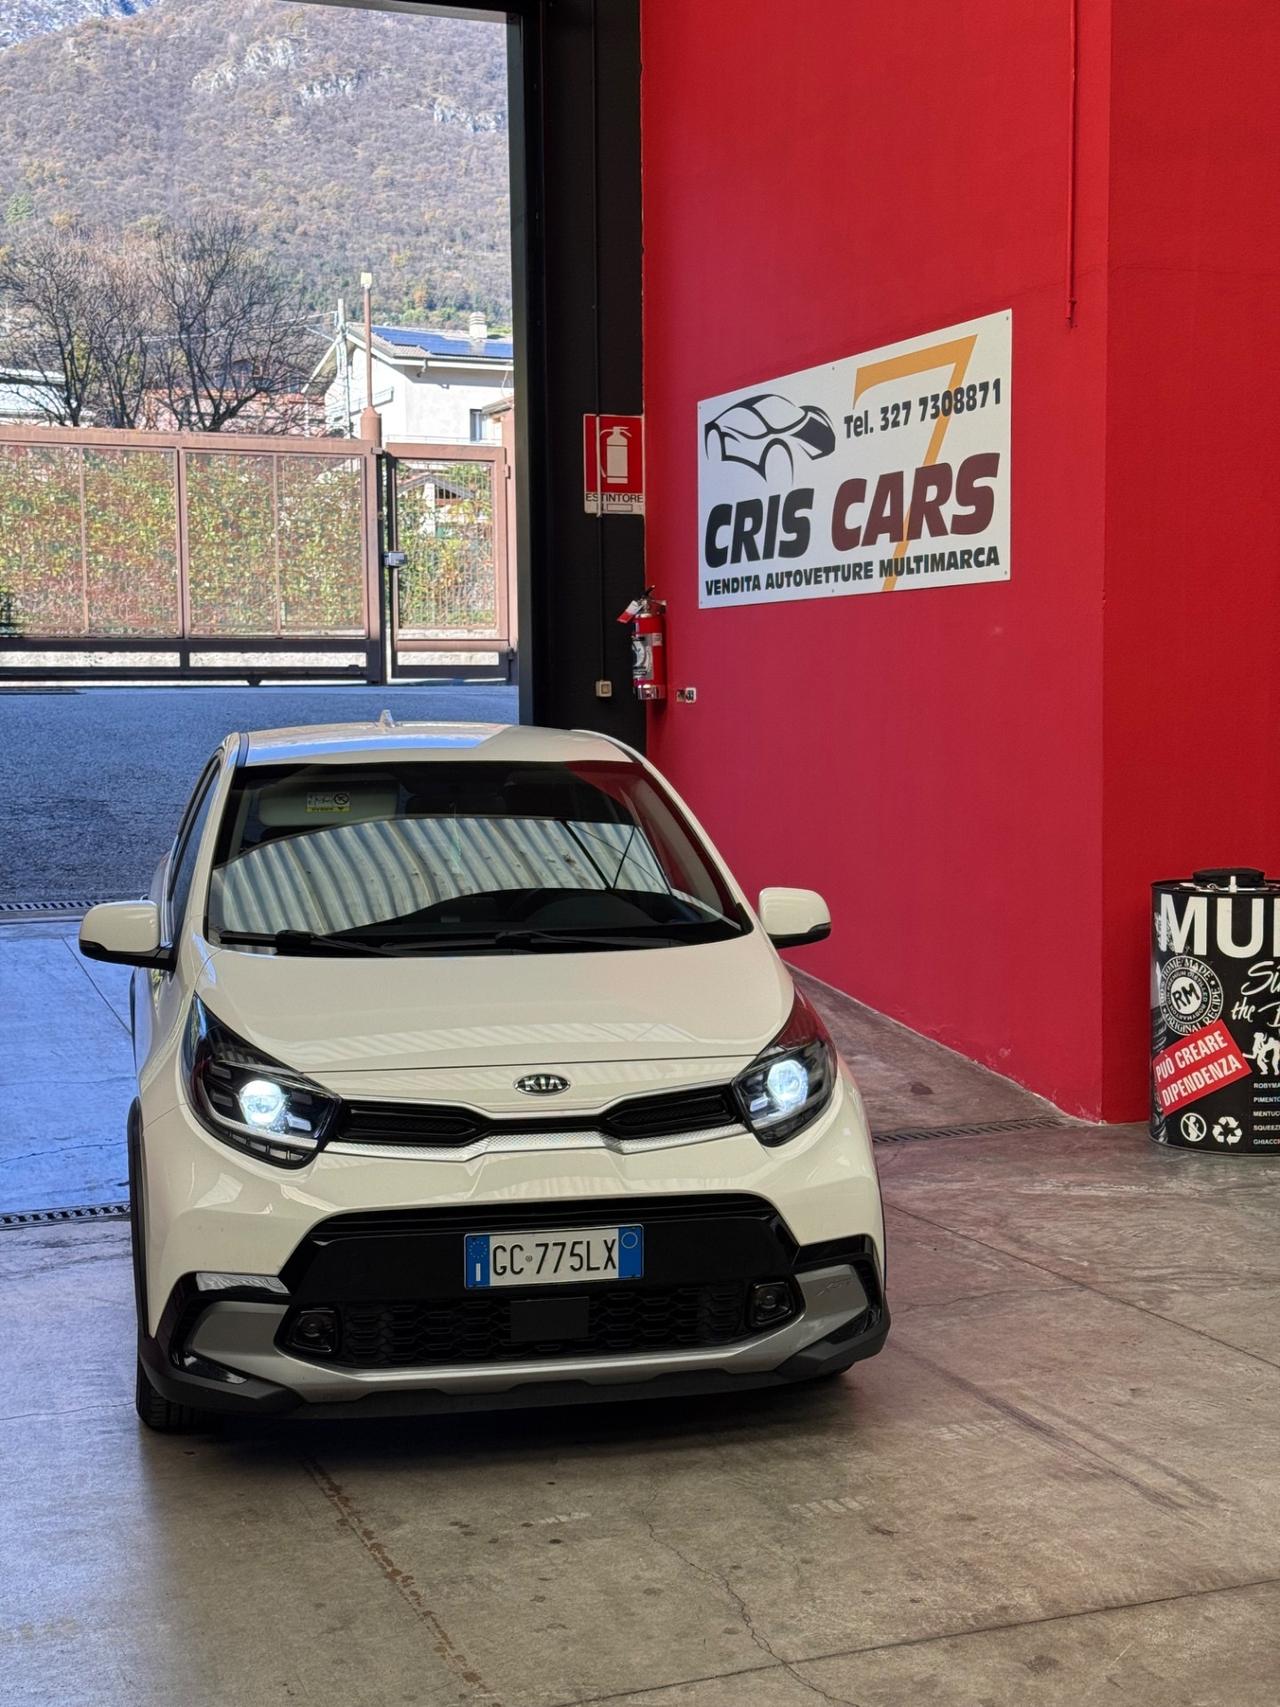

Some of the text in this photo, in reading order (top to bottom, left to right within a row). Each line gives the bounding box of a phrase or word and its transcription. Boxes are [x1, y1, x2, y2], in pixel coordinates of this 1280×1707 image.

[844, 378, 1001, 439] Tel. 327 7308871
[585, 493, 643, 503] ESTINTORE
[704, 452, 1001, 569] CRIS CARS
[705, 545, 1000, 597] VENDITA AUTOVETTURE MULTIMARCA
[1160, 893, 1280, 958] MU
[1172, 982, 1200, 1010] RM
[1231, 996, 1256, 1023] the
[1155, 1030, 1228, 1083] PUÒ CREARE
[1161, 1054, 1243, 1107] DIPENDENZA
[523, 1076, 563, 1091] KIA
[492, 1238, 617, 1276] GC 775LX
